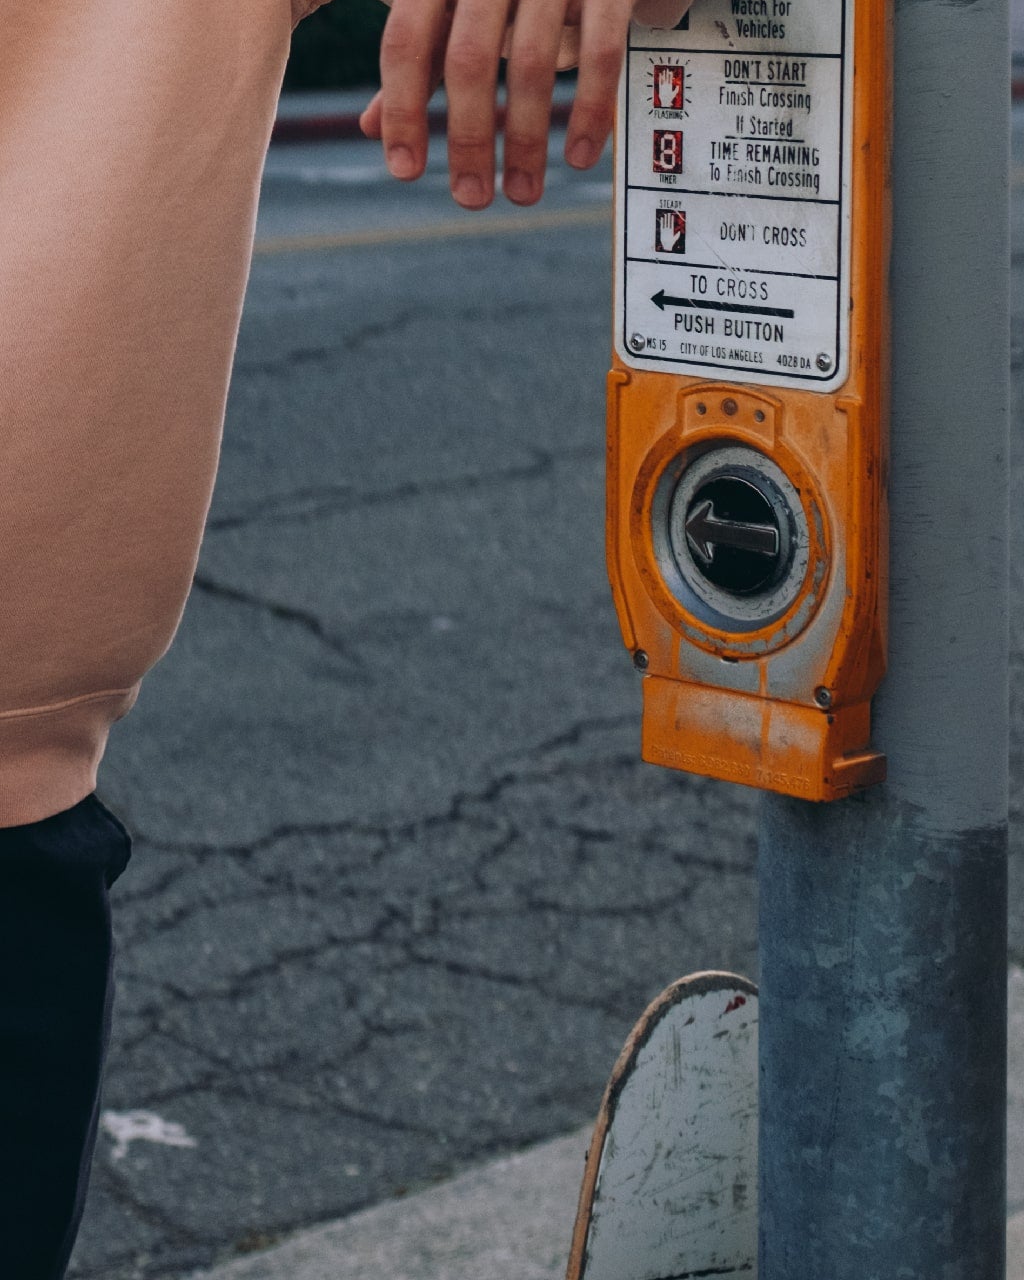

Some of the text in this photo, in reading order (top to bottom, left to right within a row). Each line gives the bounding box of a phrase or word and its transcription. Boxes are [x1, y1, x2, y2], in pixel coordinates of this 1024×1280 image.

[736, 19, 786, 39] Vehicles
[724, 59, 807, 81] DON'T START
[719, 86, 812, 115] Finish Crossing
[653, 109, 684, 120] FLASHING
[736, 115, 793, 138] If Started
[710, 141, 820, 167] TIME REMAINING
[659, 173, 677, 185] TIMER
[709, 162, 721, 182] To
[767, 166, 820, 194] Crossing
[659, 199, 682, 209] STEADY
[763, 225, 807, 248] CROSS
[690, 274, 769, 301] TO CROSS
[674, 313, 784, 344] PUSH BUTTON
[646, 337, 667, 351] MS 15
[680, 342, 763, 364] CITY OF LOS ANGELES
[800, 356, 812, 370] DA
